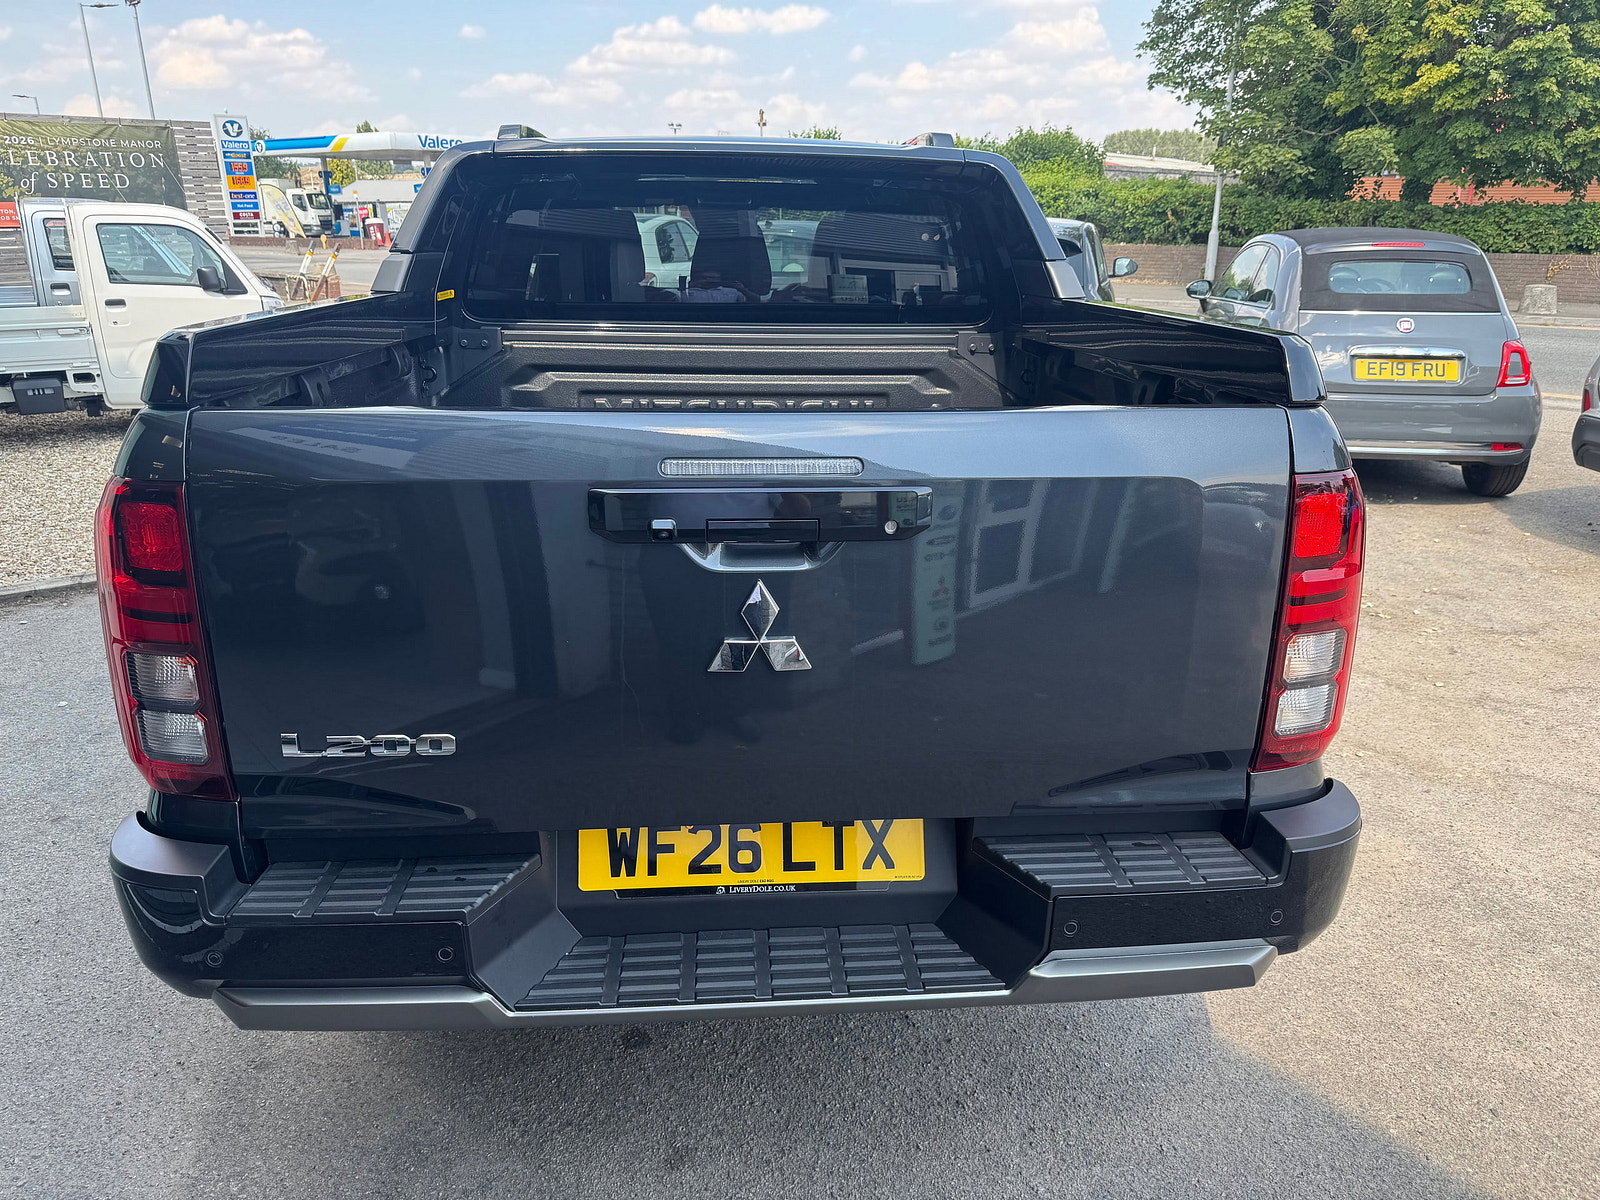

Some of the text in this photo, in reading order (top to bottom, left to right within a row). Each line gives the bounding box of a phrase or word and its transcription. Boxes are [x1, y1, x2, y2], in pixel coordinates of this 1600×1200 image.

[3, 135, 162, 149] 2026 LYMPSTONE MANOR
[221, 141, 249, 149] Valero
[0, 149, 165, 168] LEBRATION
[20, 171, 130, 195] of SPEED
[1367, 361, 1446, 377] EF19 FRU
[280, 733, 456, 758] L200
[607, 819, 896, 878] WF26 LTX
